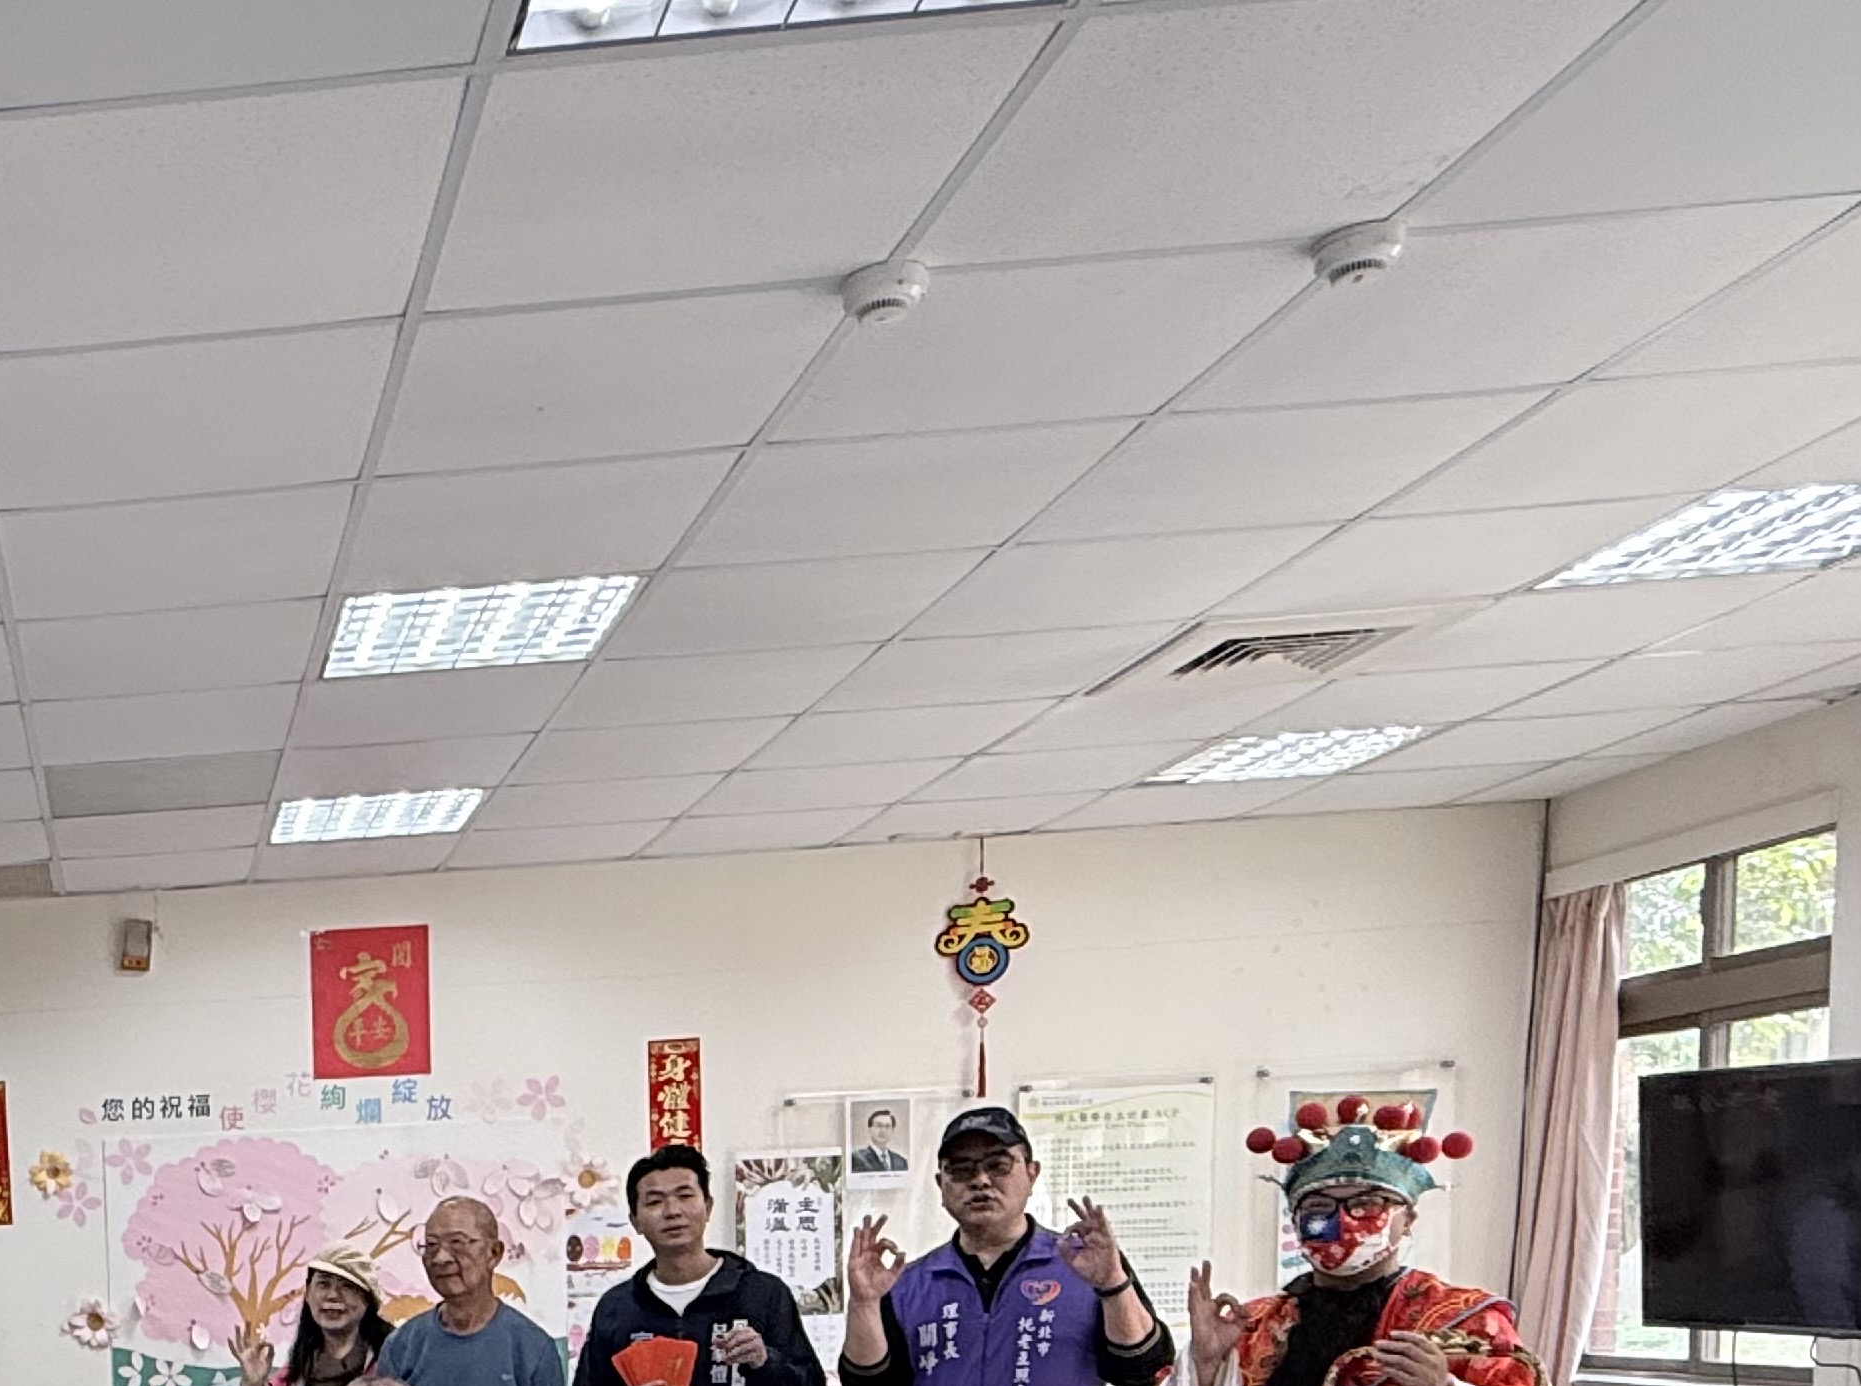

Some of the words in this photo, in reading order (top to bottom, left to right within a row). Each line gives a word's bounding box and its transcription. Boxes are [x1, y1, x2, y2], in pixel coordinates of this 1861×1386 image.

[658, 1054, 692, 1145] 身體健
[942, 1302, 960, 1359] 理事長
[1036, 1308, 1055, 1357] 新北市
